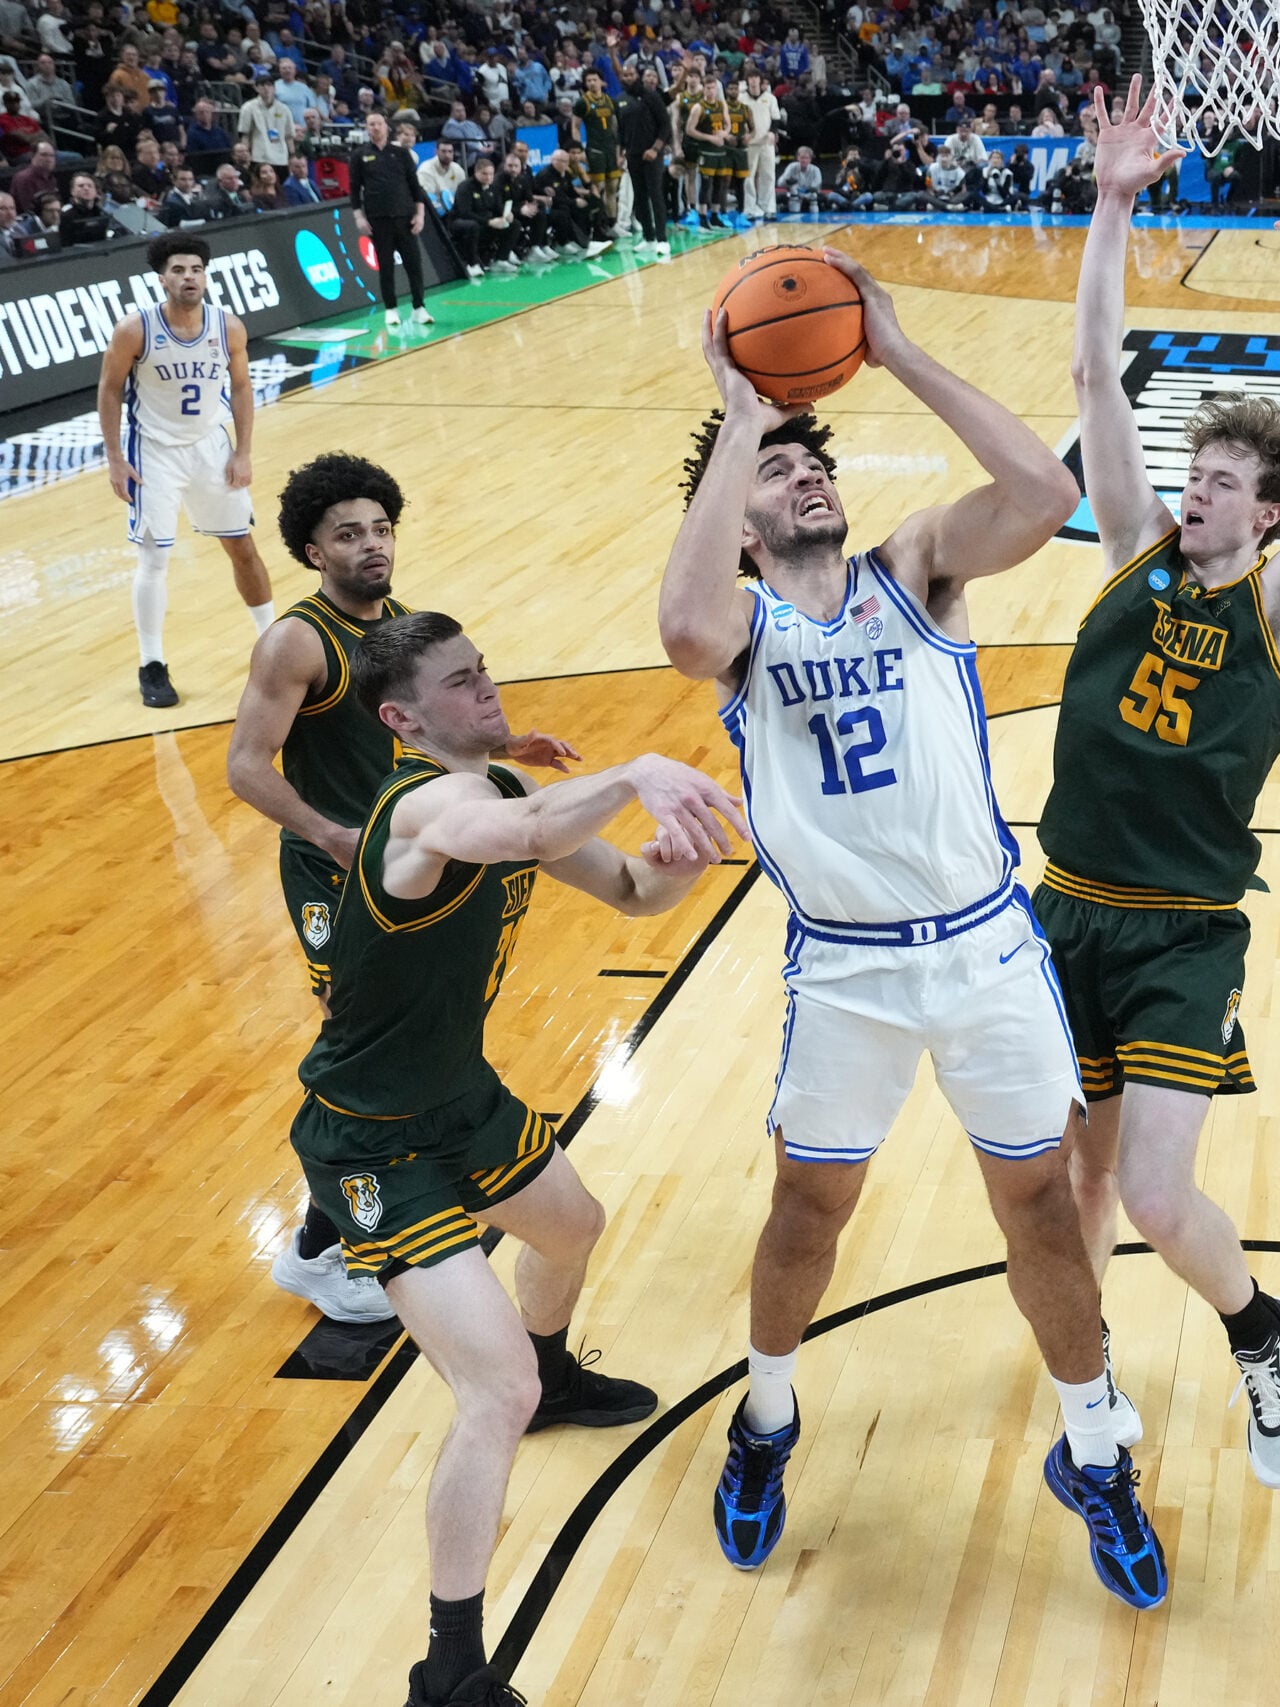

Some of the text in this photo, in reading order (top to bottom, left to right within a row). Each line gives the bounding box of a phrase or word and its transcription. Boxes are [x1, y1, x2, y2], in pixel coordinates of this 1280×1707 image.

[0, 248, 280, 379] TUDENT-ATETES
[154, 362, 221, 381] DUKE
[181, 384, 200, 415] 2
[767, 647, 904, 707] DUKE
[1118, 651, 1201, 747] 55
[808, 705, 898, 796] 12
